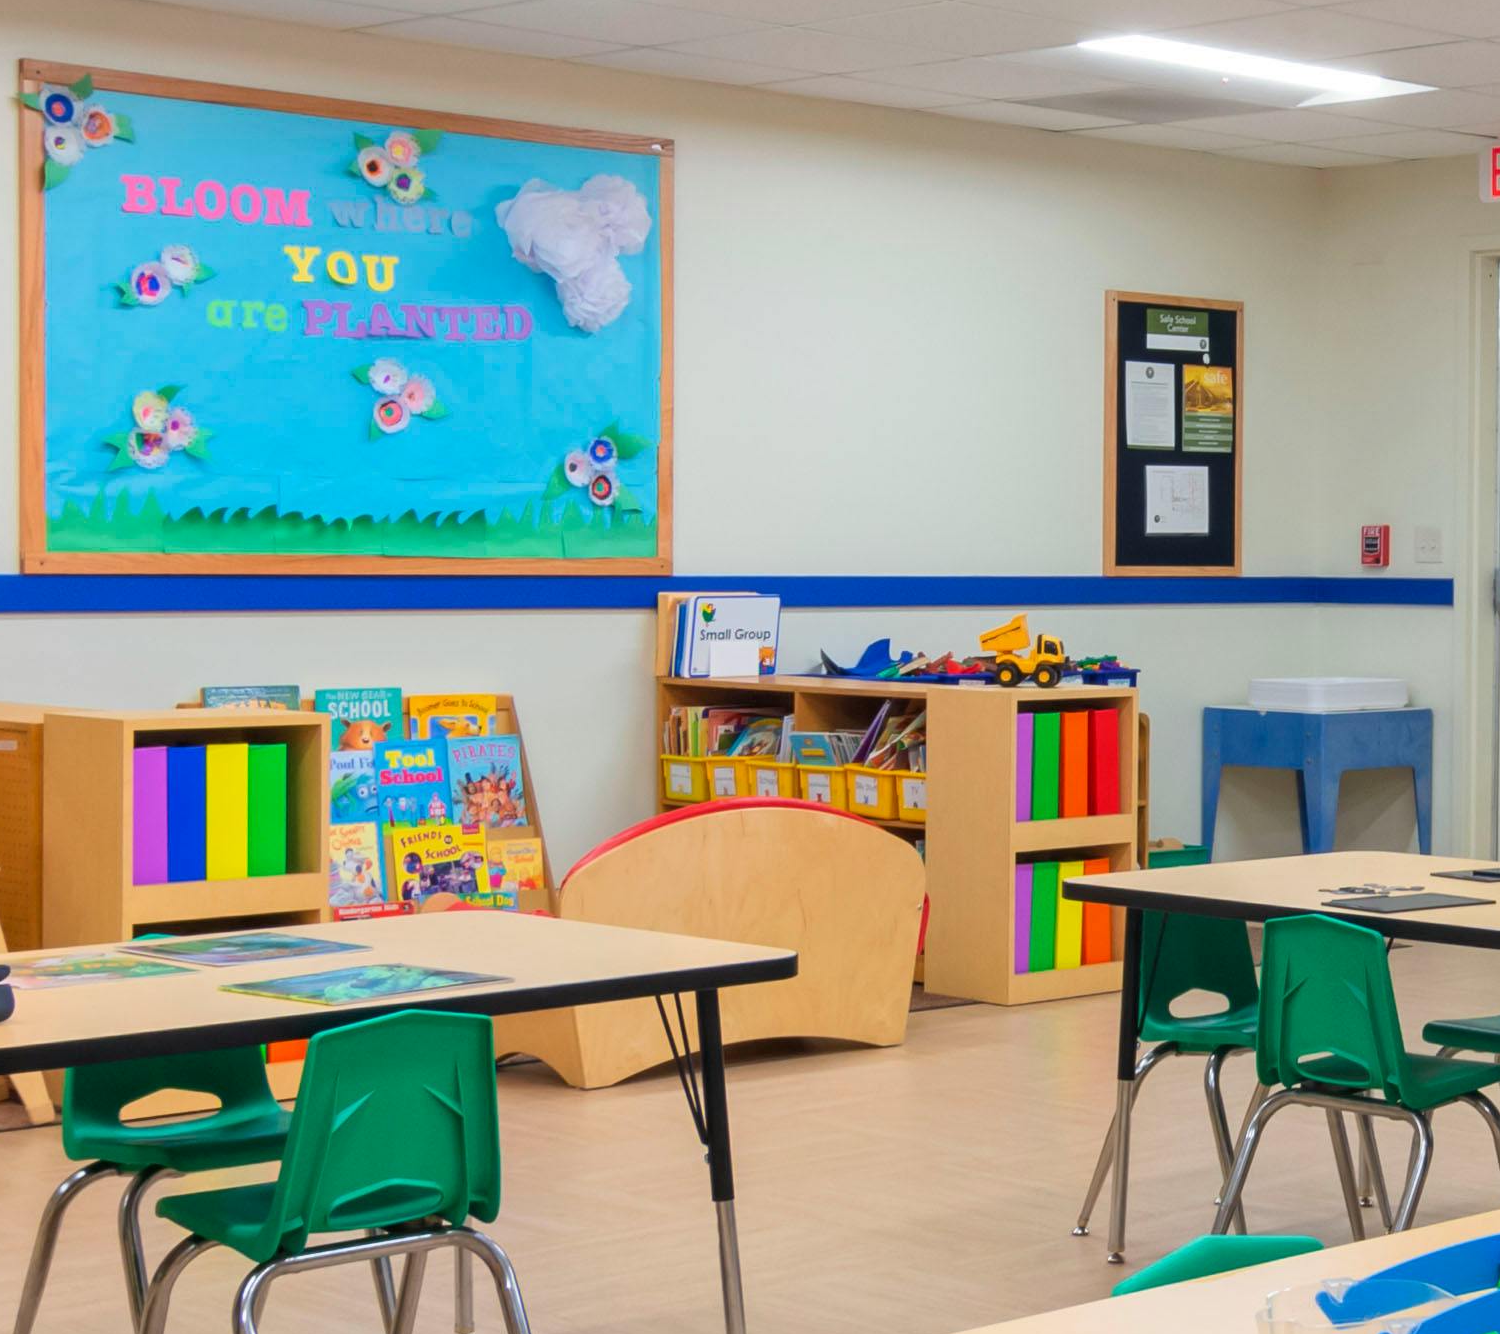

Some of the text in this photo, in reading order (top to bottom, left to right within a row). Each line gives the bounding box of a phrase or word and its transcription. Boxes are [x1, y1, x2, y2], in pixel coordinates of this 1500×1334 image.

[120, 174, 472, 237] BLOOM where
[283, 245, 399, 292] YOU
[208, 299, 533, 341] are PLANTED
[1160, 314, 1197, 325] Safe School
[1167, 323, 1189, 332] Center
[1204, 369, 1228, 386] safe
[1363, 527, 1380, 537] FIRE
[700, 628, 771, 642] Small Group
[327, 699, 391, 719] SCHOOL
[385, 749, 435, 768] Tool
[452, 743, 516, 763] PIRATES
[380, 767, 444, 786] School
[400, 831, 442, 849] FRIENDS
[425, 845, 462, 860] SCHOOL
